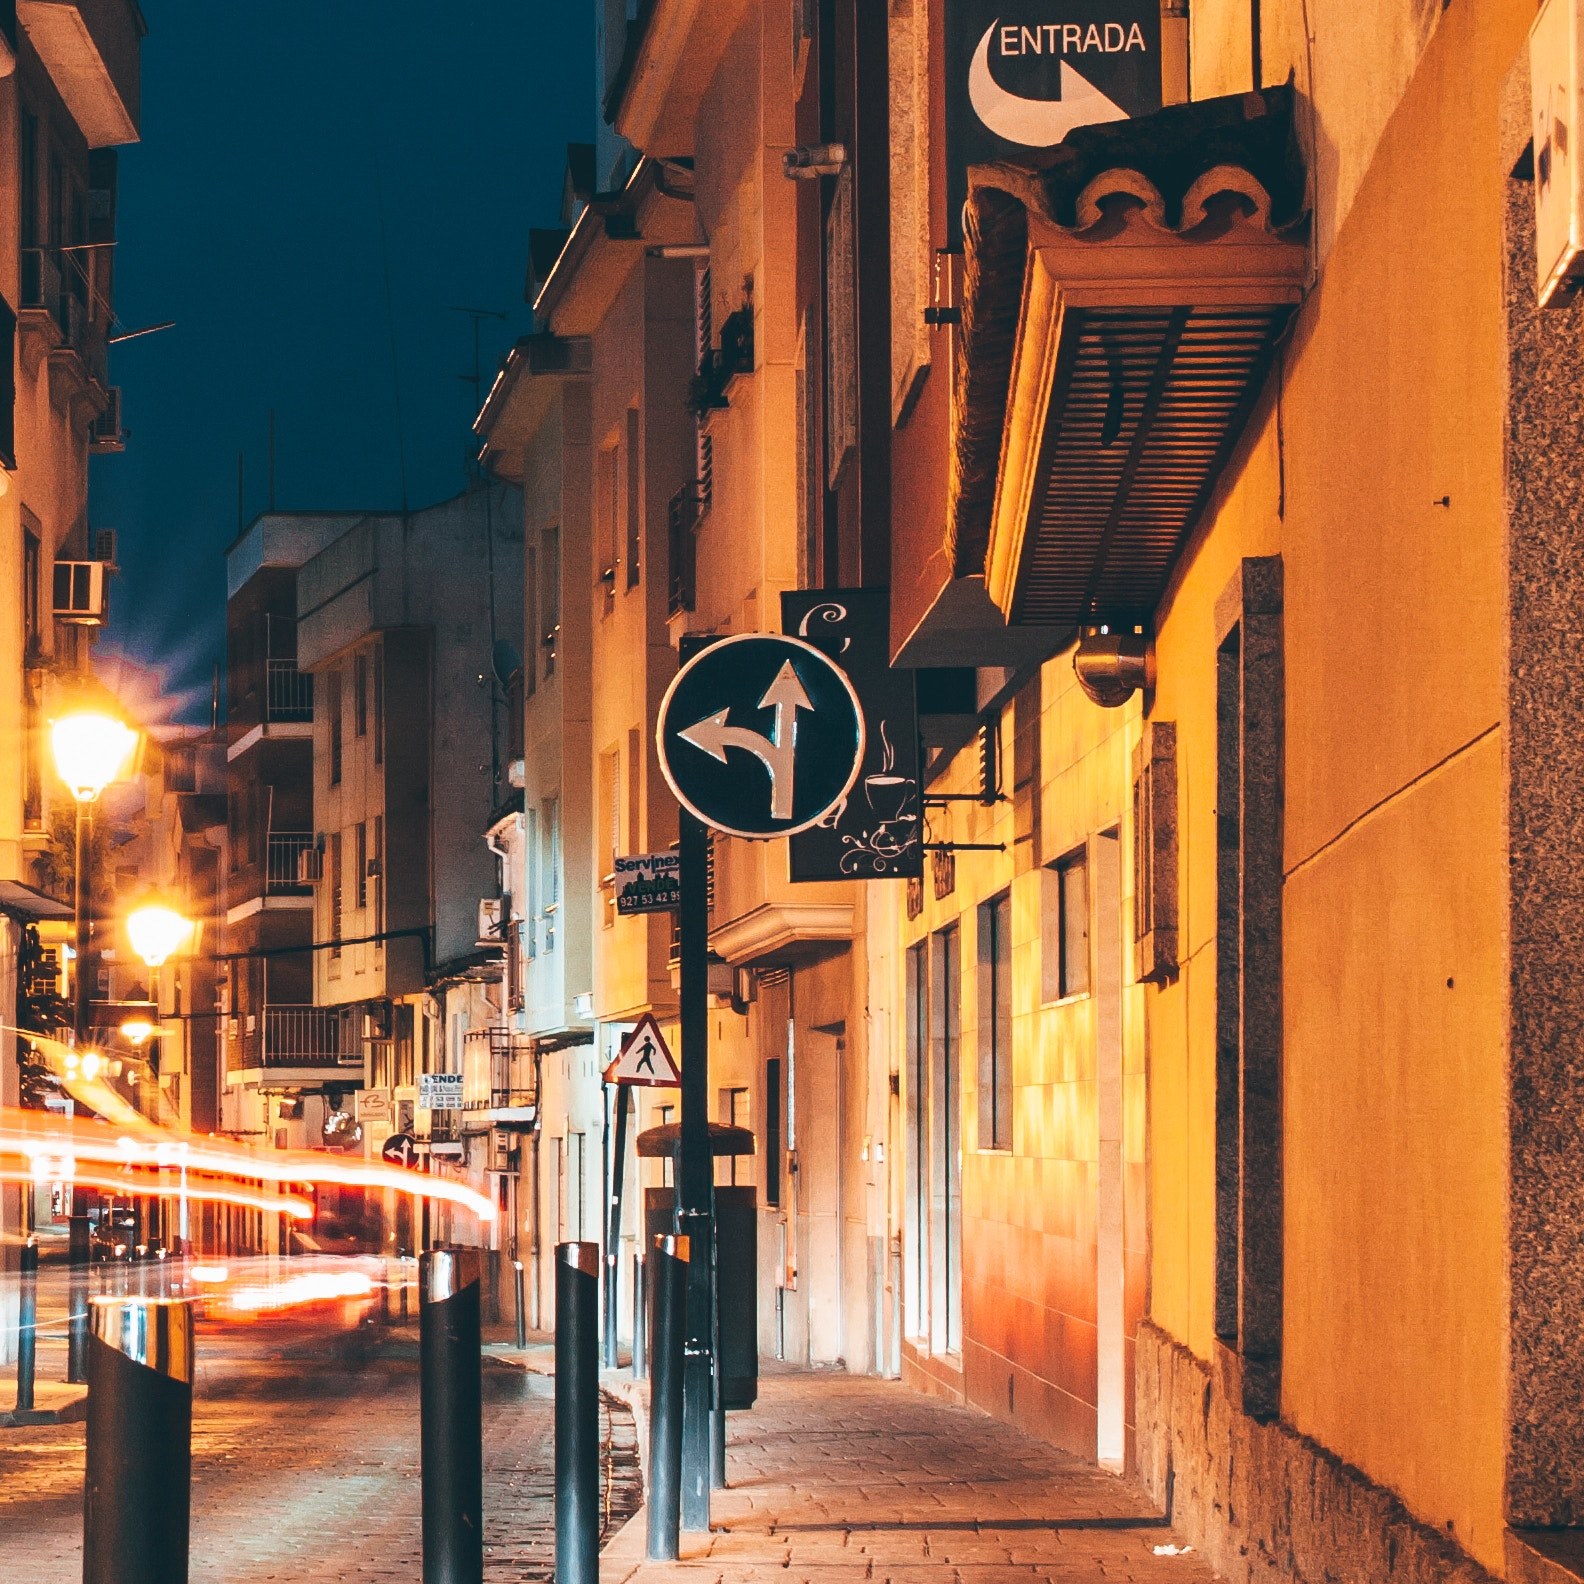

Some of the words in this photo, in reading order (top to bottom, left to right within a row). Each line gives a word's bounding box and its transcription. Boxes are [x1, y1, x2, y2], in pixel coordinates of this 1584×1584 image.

[1000, 22, 1146, 56] ENTRADA
[620, 895, 638, 907] 927
[641, 893, 653, 905] 53
[656, 891, 668, 902] 42
